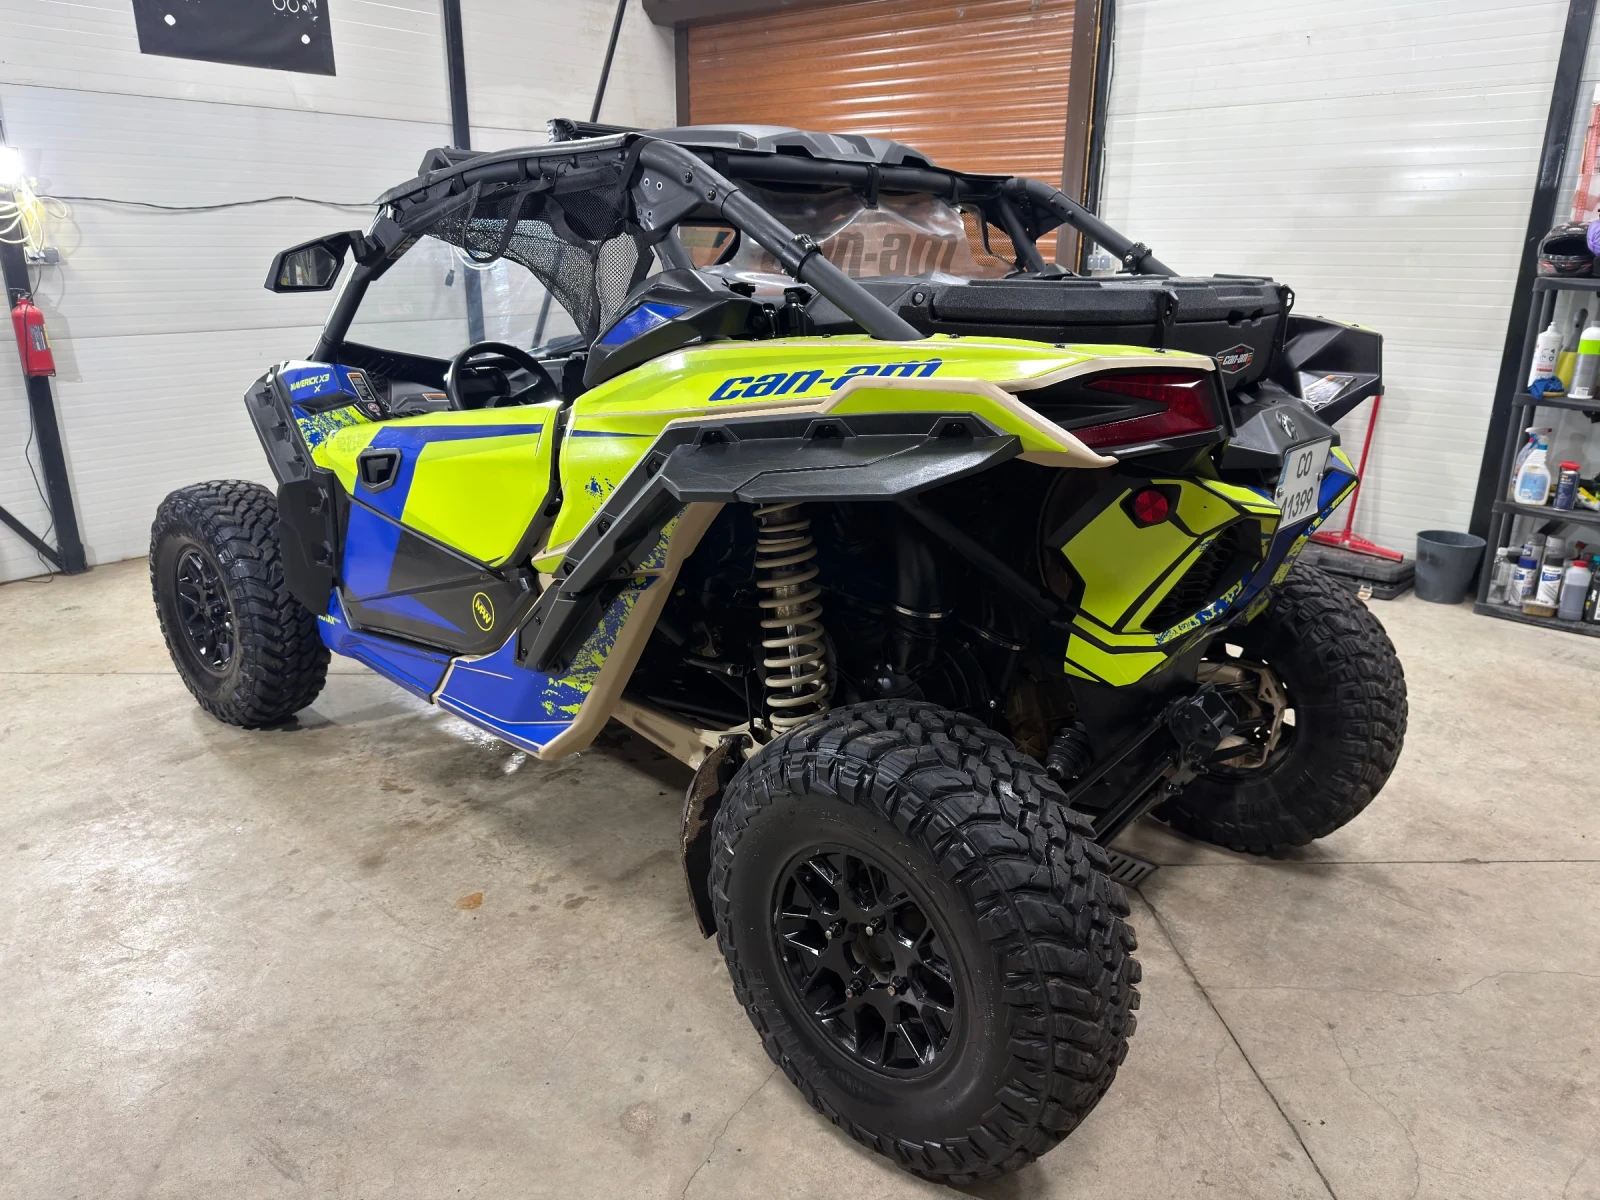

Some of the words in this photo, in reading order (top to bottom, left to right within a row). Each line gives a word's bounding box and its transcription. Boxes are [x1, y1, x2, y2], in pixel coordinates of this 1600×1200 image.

[761, 231, 958, 277] n-am
[290, 376, 319, 392] MAVERICK
[319, 373, 330, 384] X3
[1297, 450, 1313, 479] CO
[1280, 487, 1314, 522] 11399
